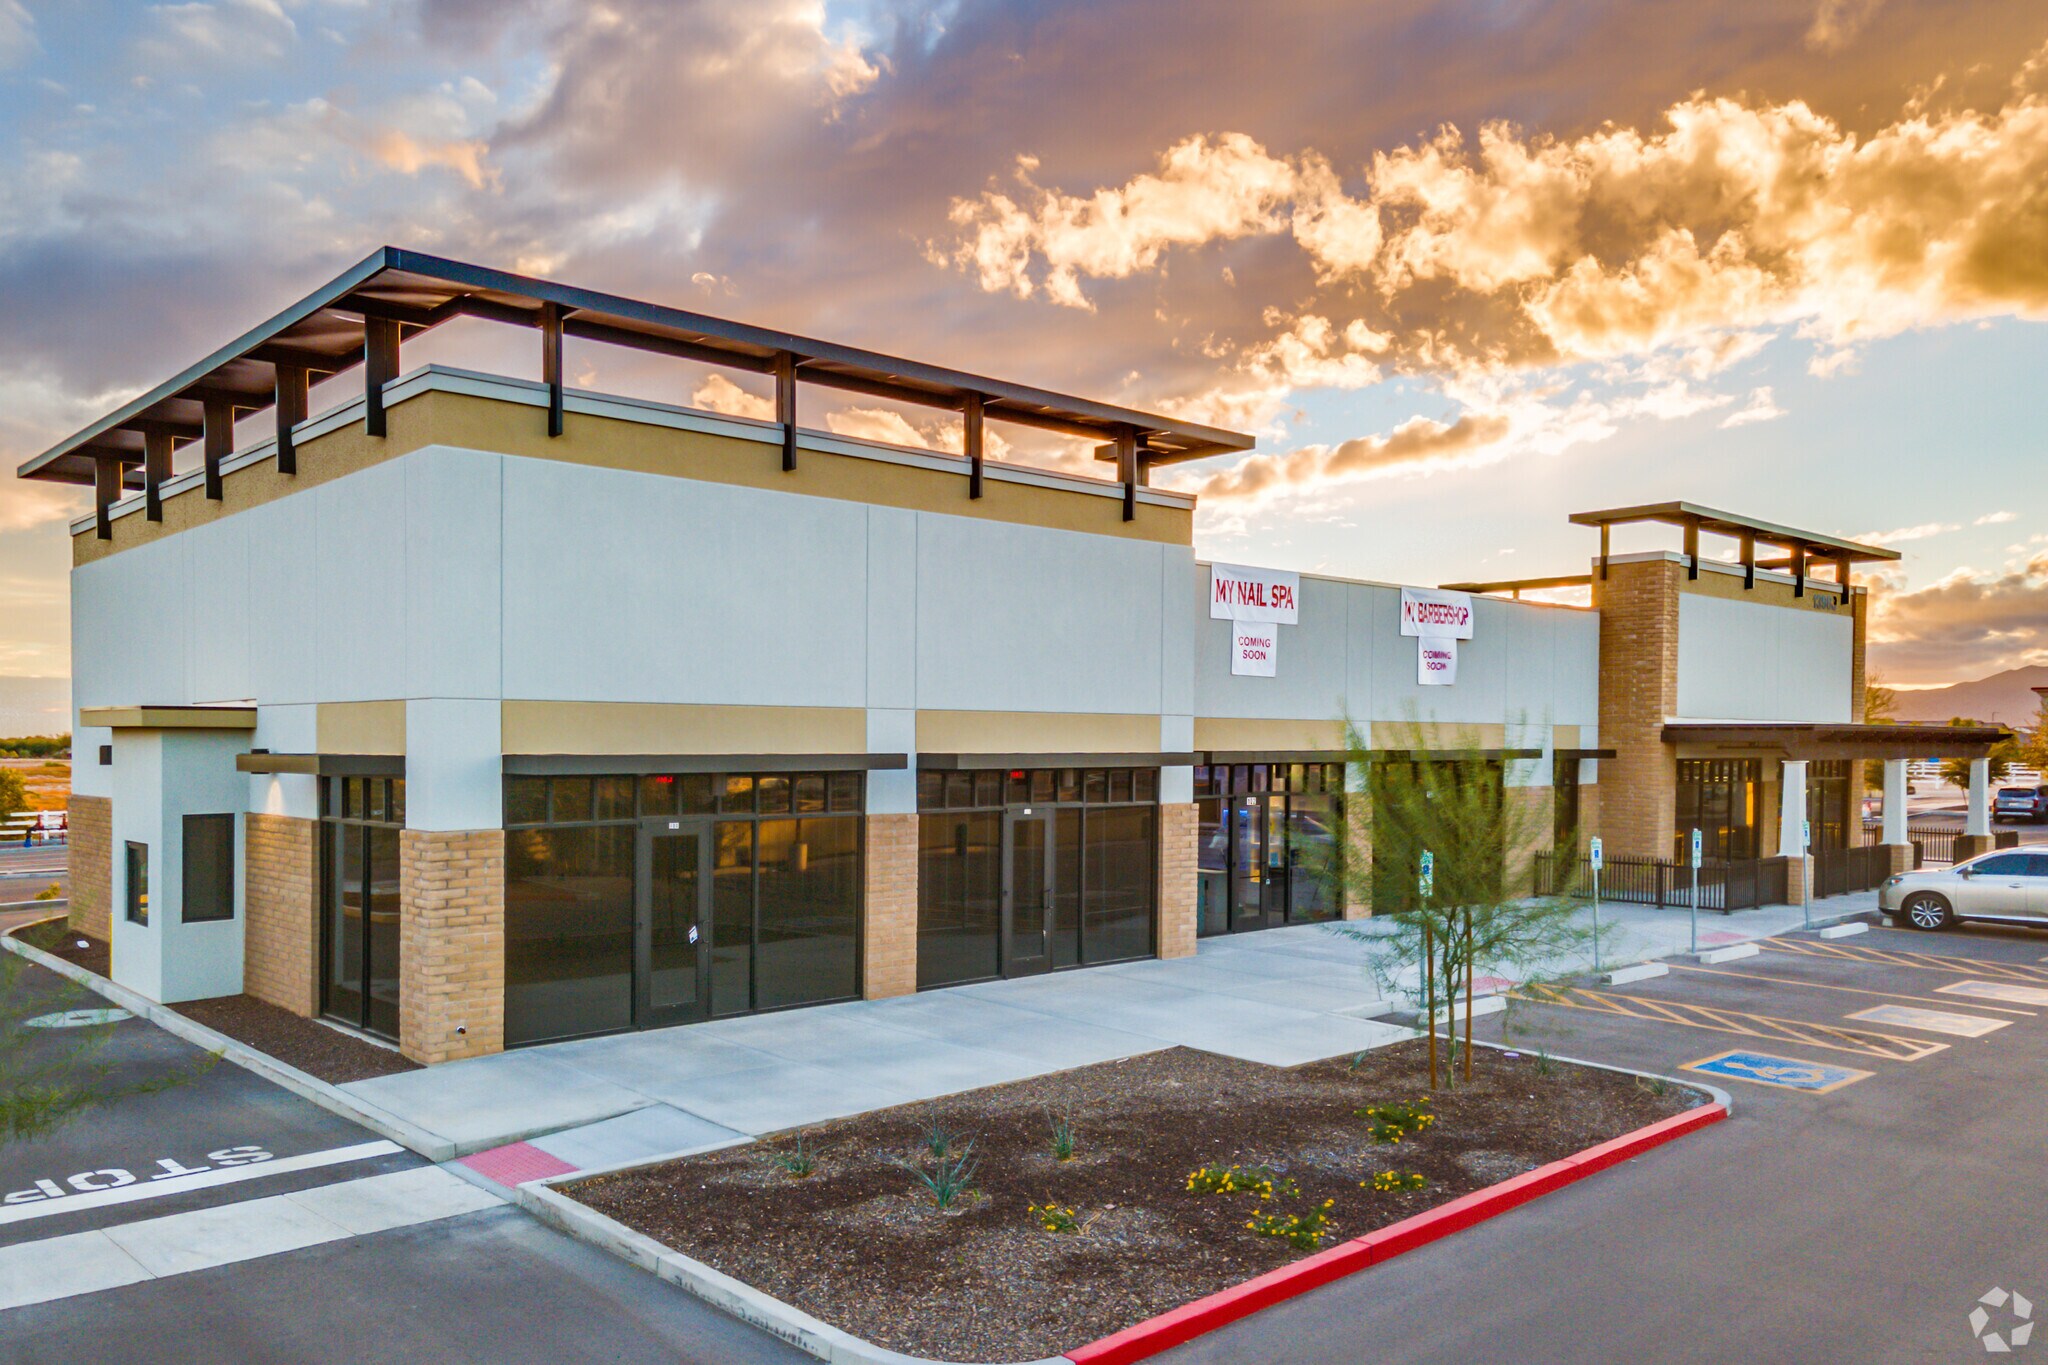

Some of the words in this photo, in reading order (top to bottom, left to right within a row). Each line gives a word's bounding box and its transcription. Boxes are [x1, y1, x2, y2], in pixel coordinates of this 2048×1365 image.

[1216, 579, 1234, 604] MY
[1238, 581, 1267, 607] NAIL
[1271, 584, 1294, 609] SPA
[1418, 602, 1469, 626] BARBERSHOP
[1238, 636, 1271, 648] COMING
[1242, 650, 1267, 660] SOON
[1423, 650, 1452, 660] COMING
[1426, 661, 1447, 671] SOON
[4, 1145, 274, 1205] STOP
